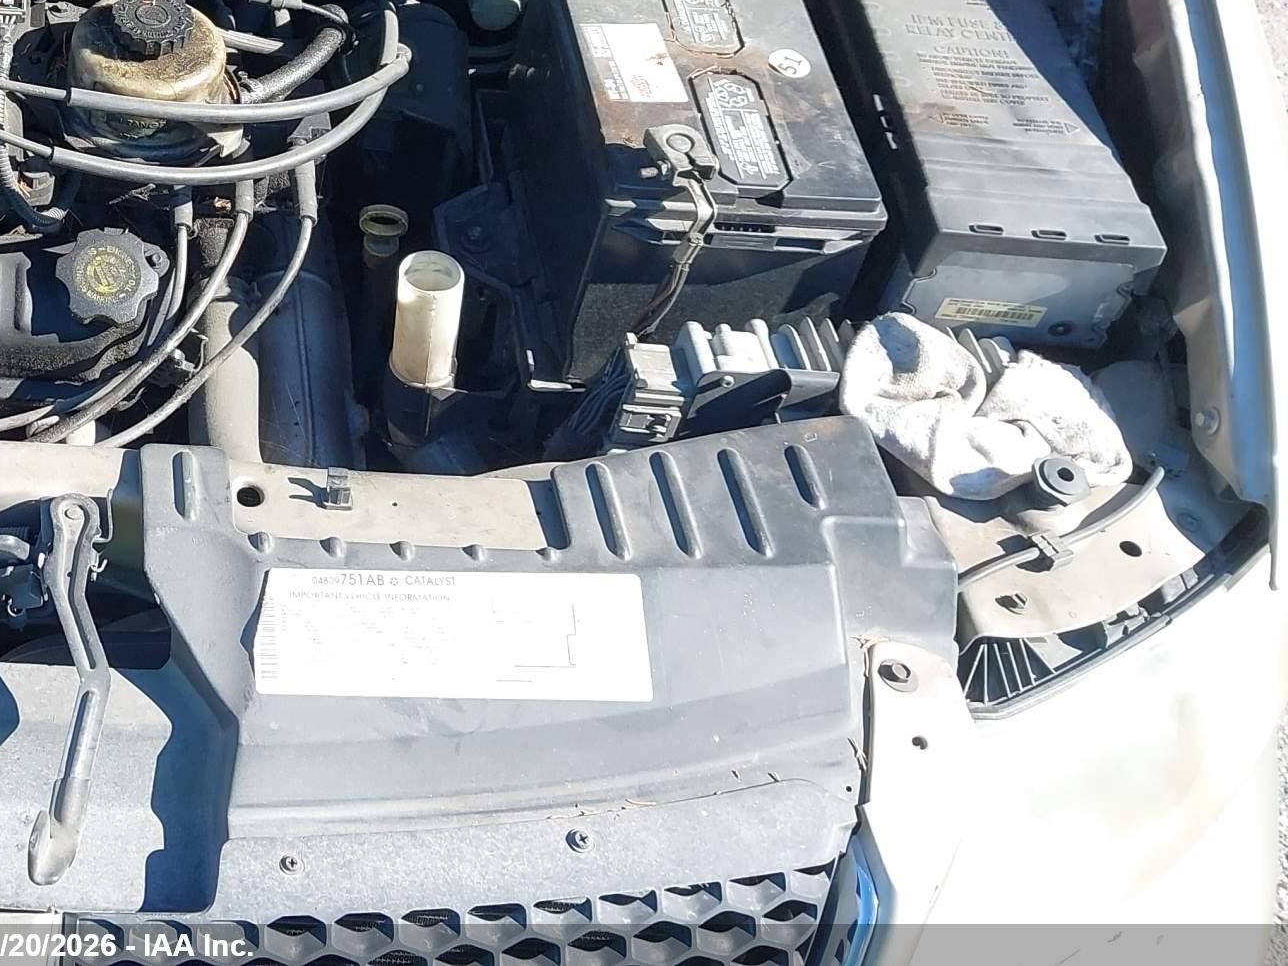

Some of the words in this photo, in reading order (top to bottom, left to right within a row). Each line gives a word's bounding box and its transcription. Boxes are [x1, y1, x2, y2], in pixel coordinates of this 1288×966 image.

[904, 24, 955, 38] RELAY
[777, 55, 804, 76] 51
[404, 575, 456, 587] CATALYST
